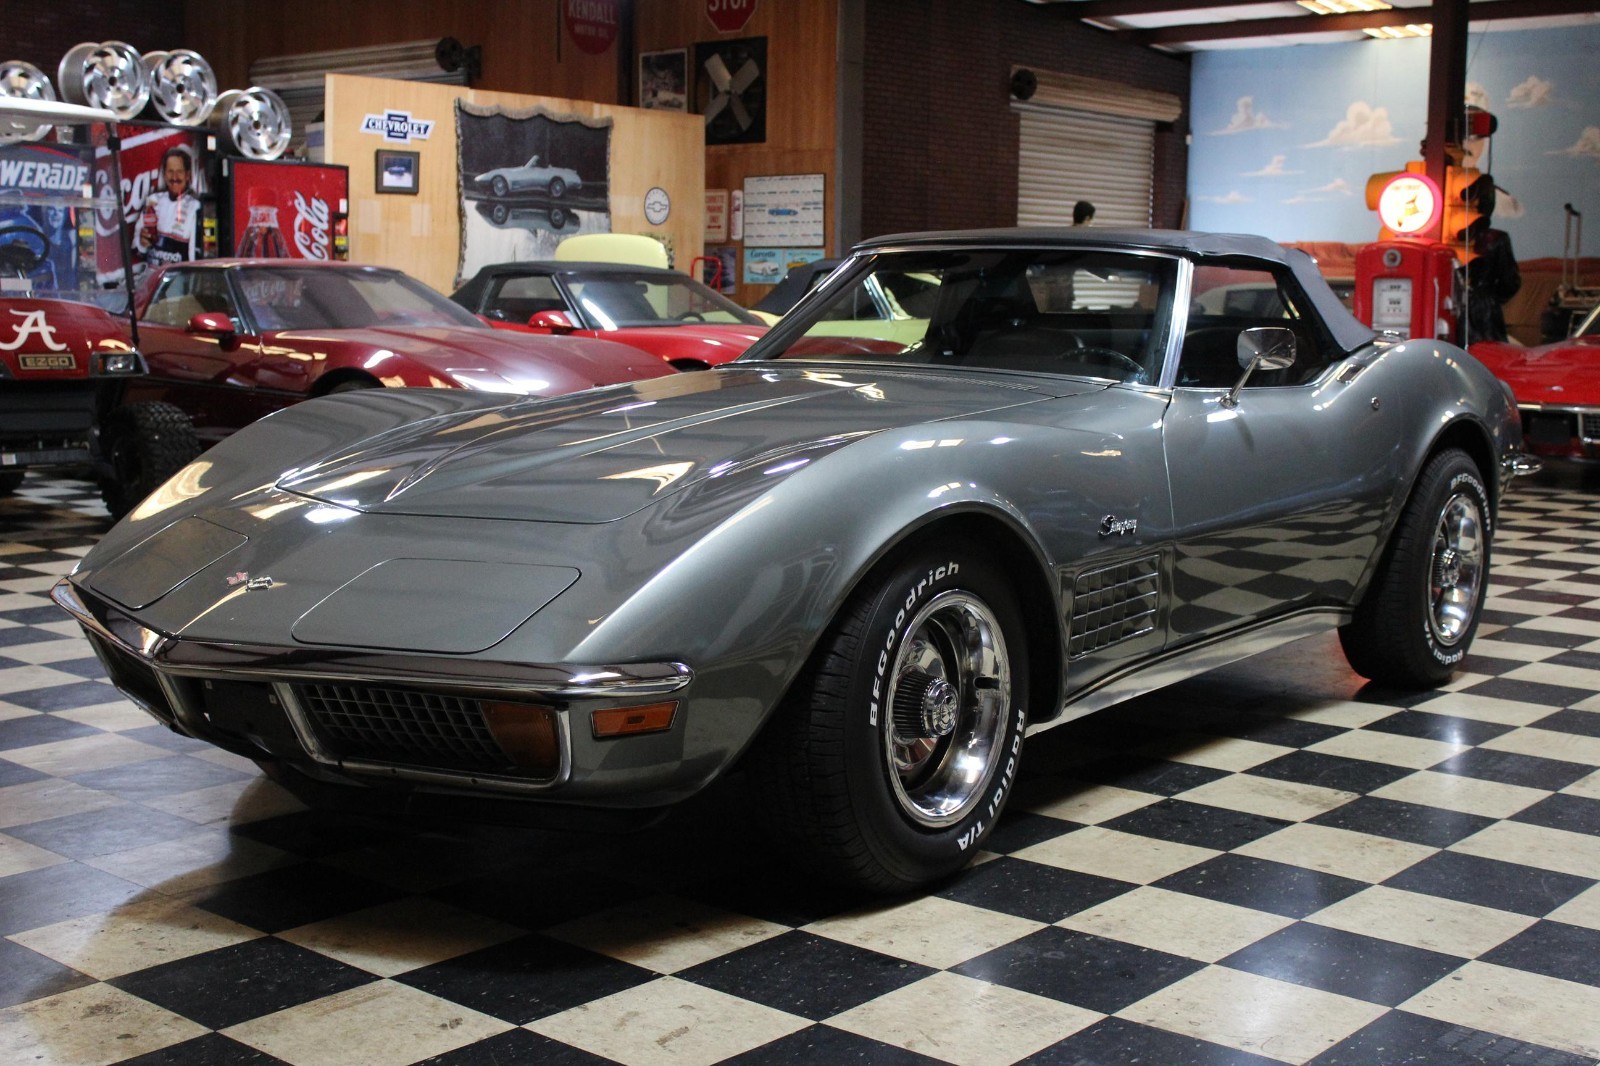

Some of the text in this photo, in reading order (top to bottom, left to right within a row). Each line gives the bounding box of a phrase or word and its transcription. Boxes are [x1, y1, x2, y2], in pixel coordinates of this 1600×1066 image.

[368, 118, 427, 135] CHEVROLET
[0, 309, 67, 351] A
[869, 561, 959, 727] BFGoodrich
[1433, 648, 1464, 666] Radial
[956, 709, 1025, 851] Radial T/A
